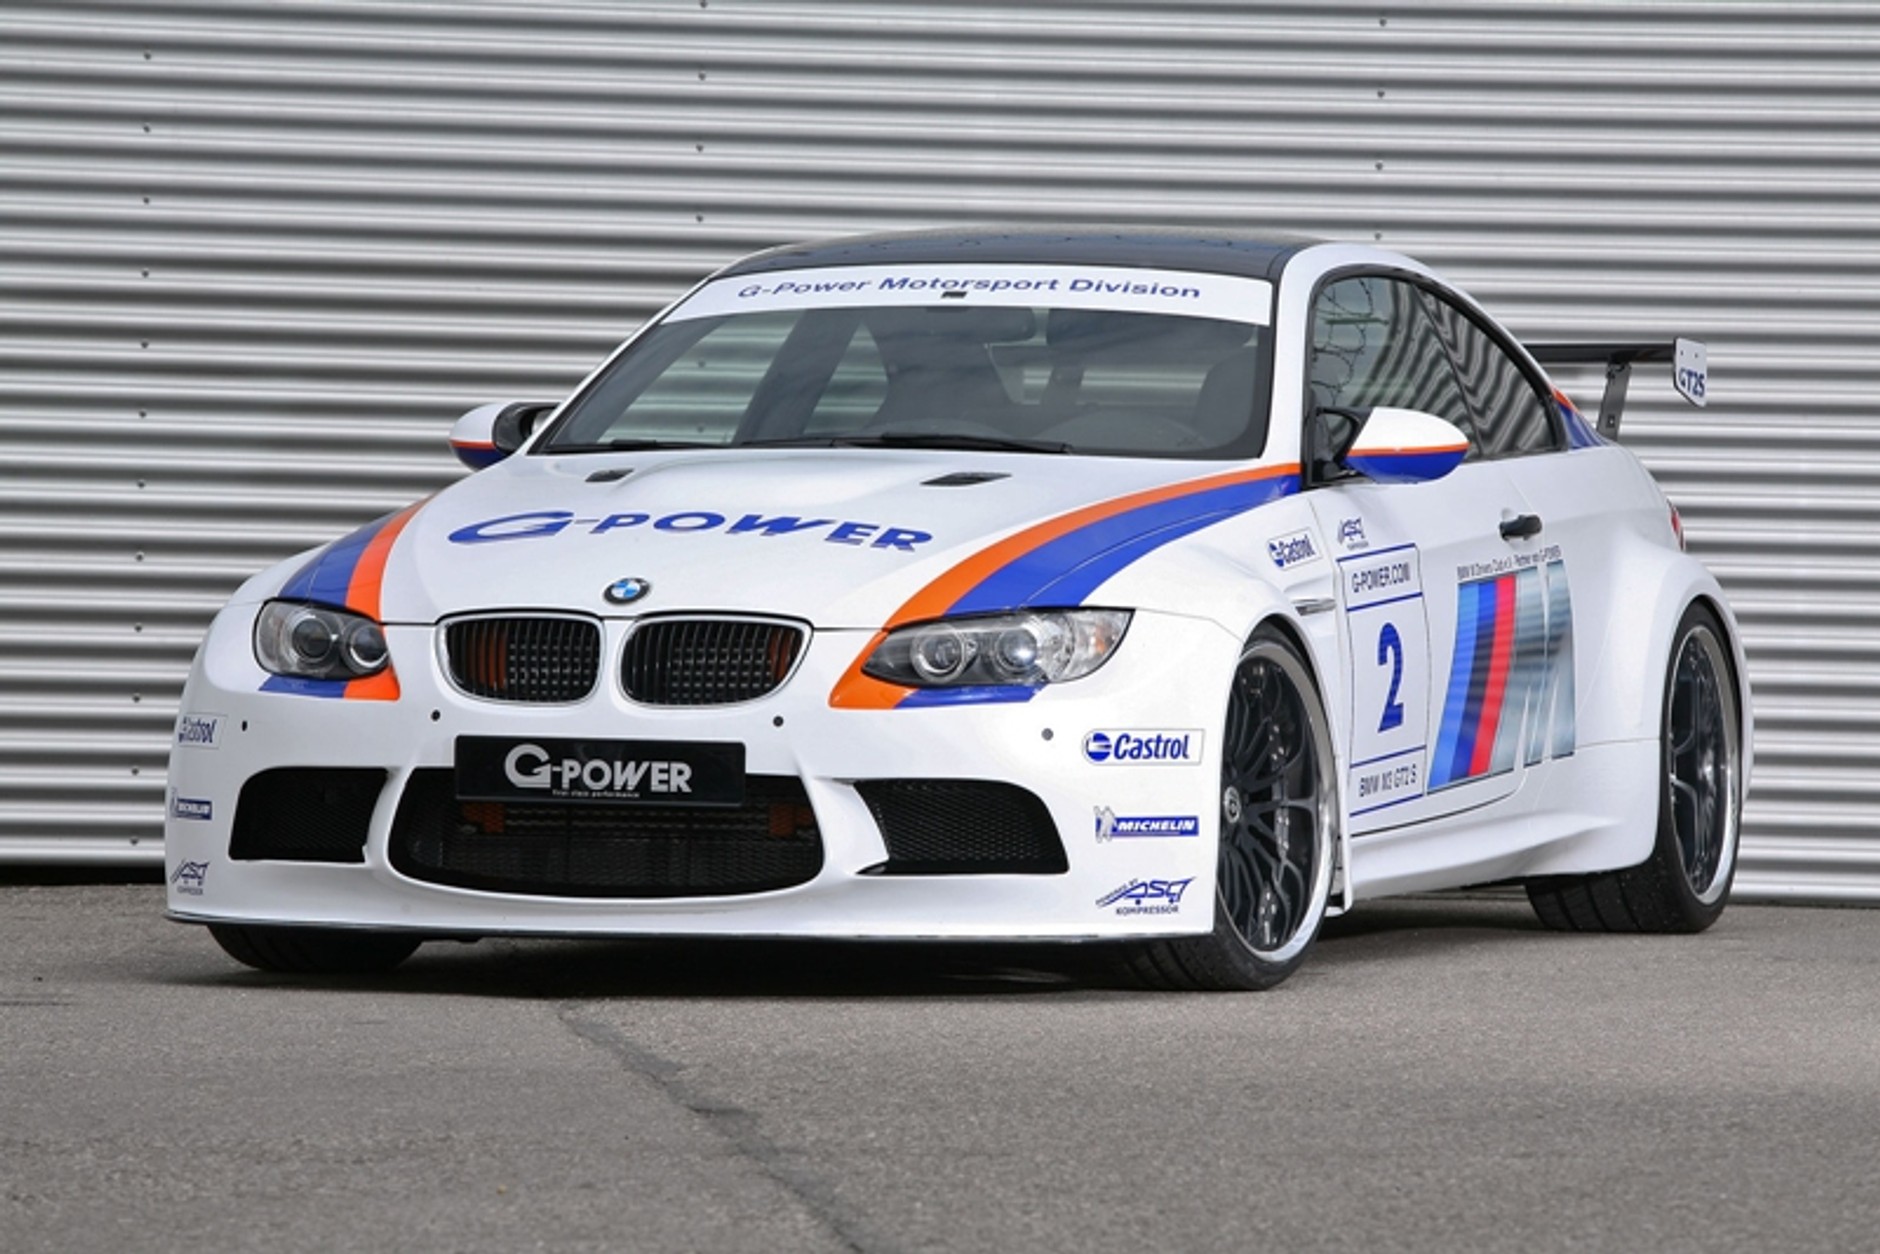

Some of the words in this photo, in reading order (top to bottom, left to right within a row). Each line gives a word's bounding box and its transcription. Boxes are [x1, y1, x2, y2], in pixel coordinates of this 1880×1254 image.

[738, 281, 872, 298] G-Power
[878, 277, 1060, 293] Motorsport
[1069, 278, 1201, 299] Division
[447, 510, 934, 553] G-POWER
[1352, 563, 1411, 593] G-POWER.COM
[1377, 622, 1404, 733] 2
[1114, 732, 1190, 760] Castrol
[504, 743, 692, 793] G-POWER
[1118, 820, 1196, 831] MICHELIN
[1116, 905, 1179, 916] KOMPRESSOR
